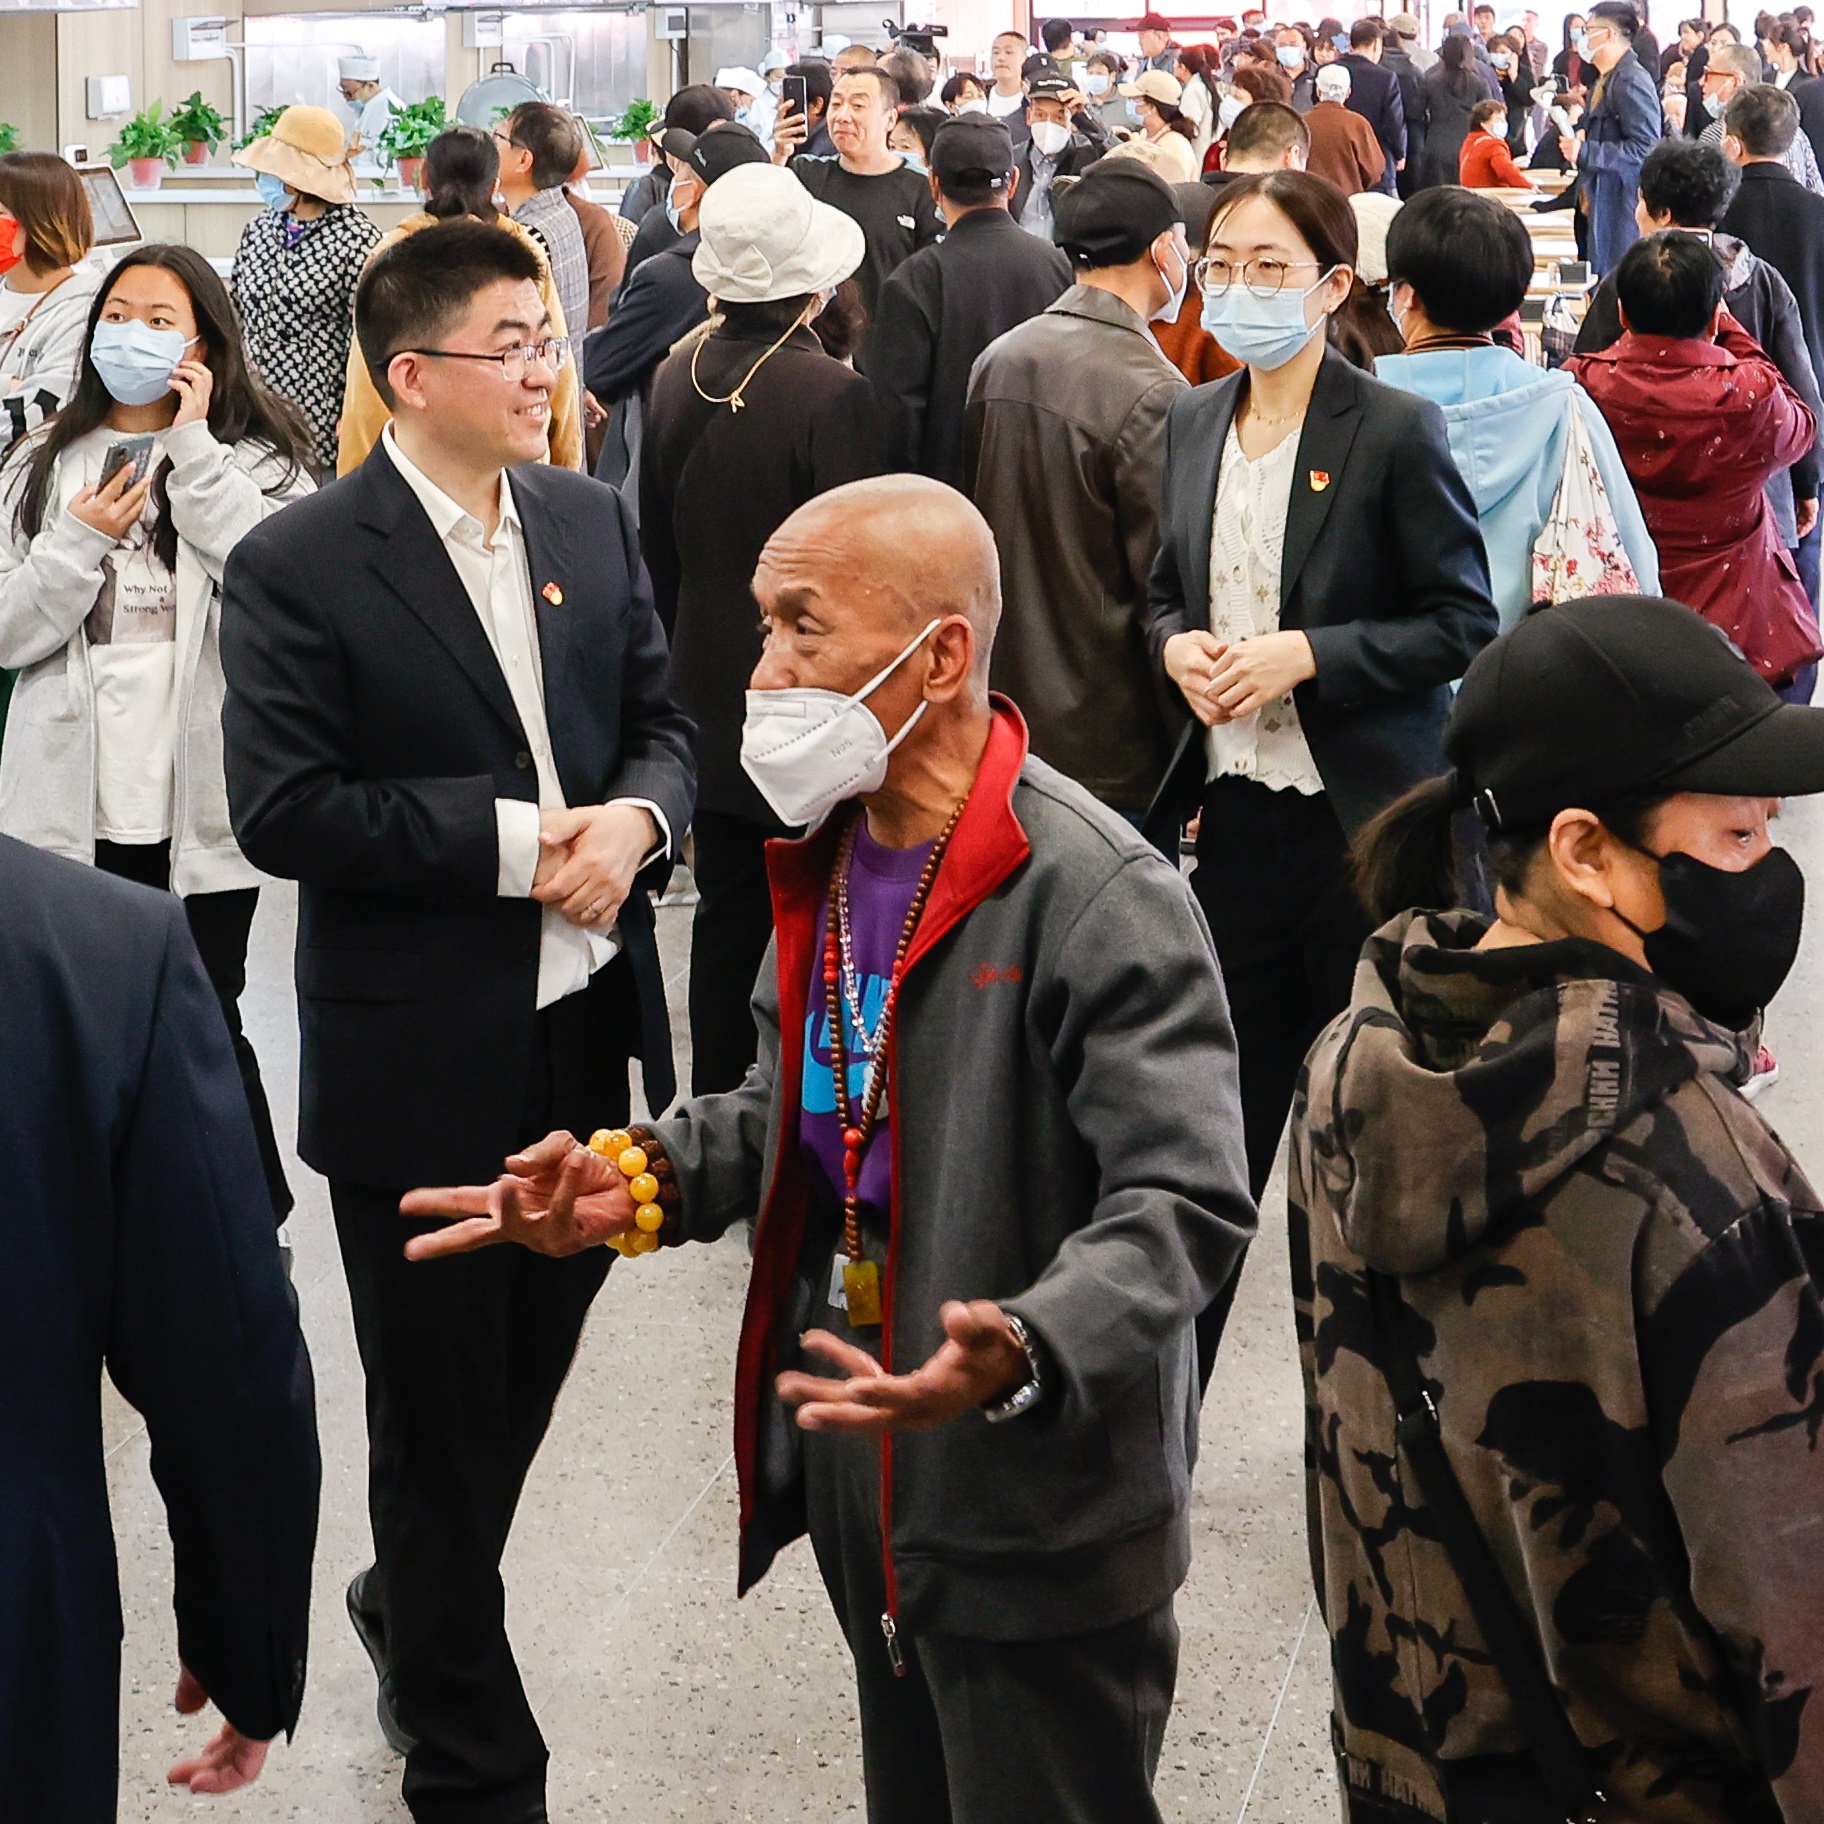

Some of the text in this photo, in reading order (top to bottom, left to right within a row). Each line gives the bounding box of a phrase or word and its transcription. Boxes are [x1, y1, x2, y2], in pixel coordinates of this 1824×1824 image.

[123, 584, 167, 595] Why Not
[123, 604, 158, 615] Strong
